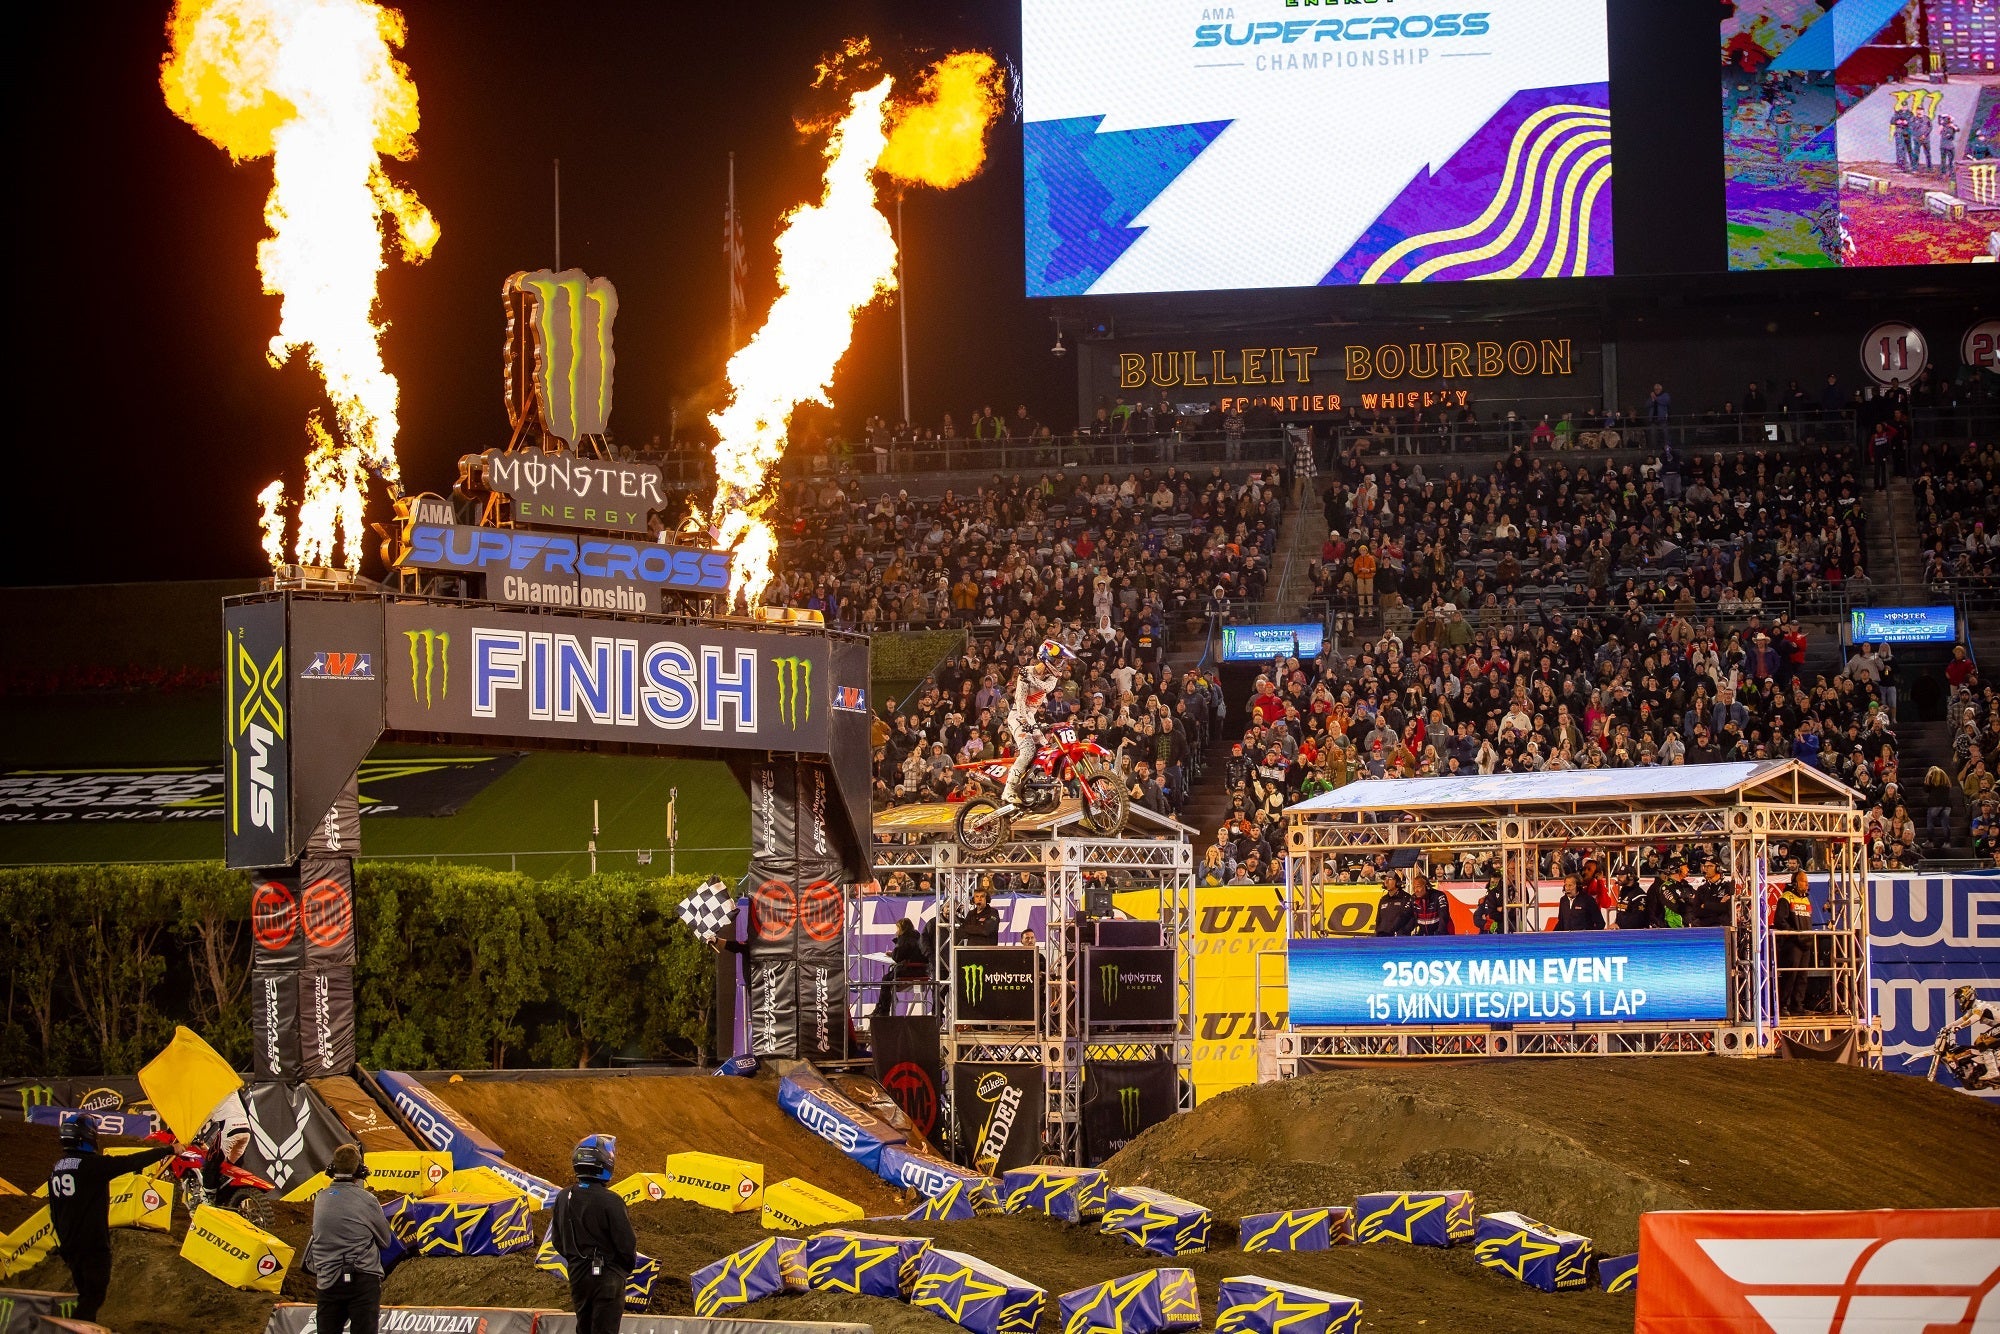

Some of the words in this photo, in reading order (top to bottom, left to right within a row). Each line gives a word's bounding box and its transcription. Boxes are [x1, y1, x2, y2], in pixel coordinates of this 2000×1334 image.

[1202, 8, 1235, 21] AMA
[1192, 12, 1491, 48] SUPERCROSS
[1255, 48, 1430, 71] CHAMPIONSHIP
[1880, 336, 1908, 370] 11
[1973, 333, 2000, 367] 2
[1119, 346, 1318, 388] BULLEIT
[1345, 338, 1572, 381] BOURBON
[493, 455, 663, 504] MONSTER
[419, 502, 454, 525] AMA
[521, 502, 637, 525] ENERGY
[408, 526, 733, 589] SUPERCROSS
[503, 575, 647, 613] Championship
[1884, 612, 1927, 620] MONSTER
[1866, 625, 1948, 635] SUPERCROSS
[300, 652, 376, 677] AMA
[471, 627, 759, 733] FINISH
[832, 686, 867, 710] AMA
[1060, 729, 1077, 744] 18
[985, 764, 1007, 778] 18
[984, 972, 1034, 984] MONSTER
[1119, 972, 1163, 984] MONSTER
[1381, 960, 1462, 988] 250SX
[1468, 959, 1540, 986] MAIN
[1543, 956, 1628, 984] EVENT
[315, 975, 323, 1026] MOUNTAIN
[1366, 993, 1390, 1020] 15
[1397, 991, 1576, 1019] MINUTES/PLUS
[1582, 991, 1592, 1016] 1
[1600, 988, 1647, 1015] LAP
[980, 1077, 1005, 1096] mike's
[83, 1094, 120, 1112] mike's
[797, 1098, 859, 1153] WPS
[373, 1168, 421, 1180] DUNLOP
[676, 1174, 731, 1193] DUNLOP
[11, 1222, 51, 1262] DUNLOP
[196, 1226, 251, 1261] DUNLOP
[497, 1234, 530, 1250] SUPERCROSS
[1450, 1228, 1475, 1239] SUPERCROSS
[1177, 1246, 1206, 1257] SUPERCROSS
[1556, 1277, 1587, 1288] SUPERCROSS
[382, 1310, 479, 1333] MOUNTAIN
[1167, 1313, 1200, 1322] SUPERCROSS
